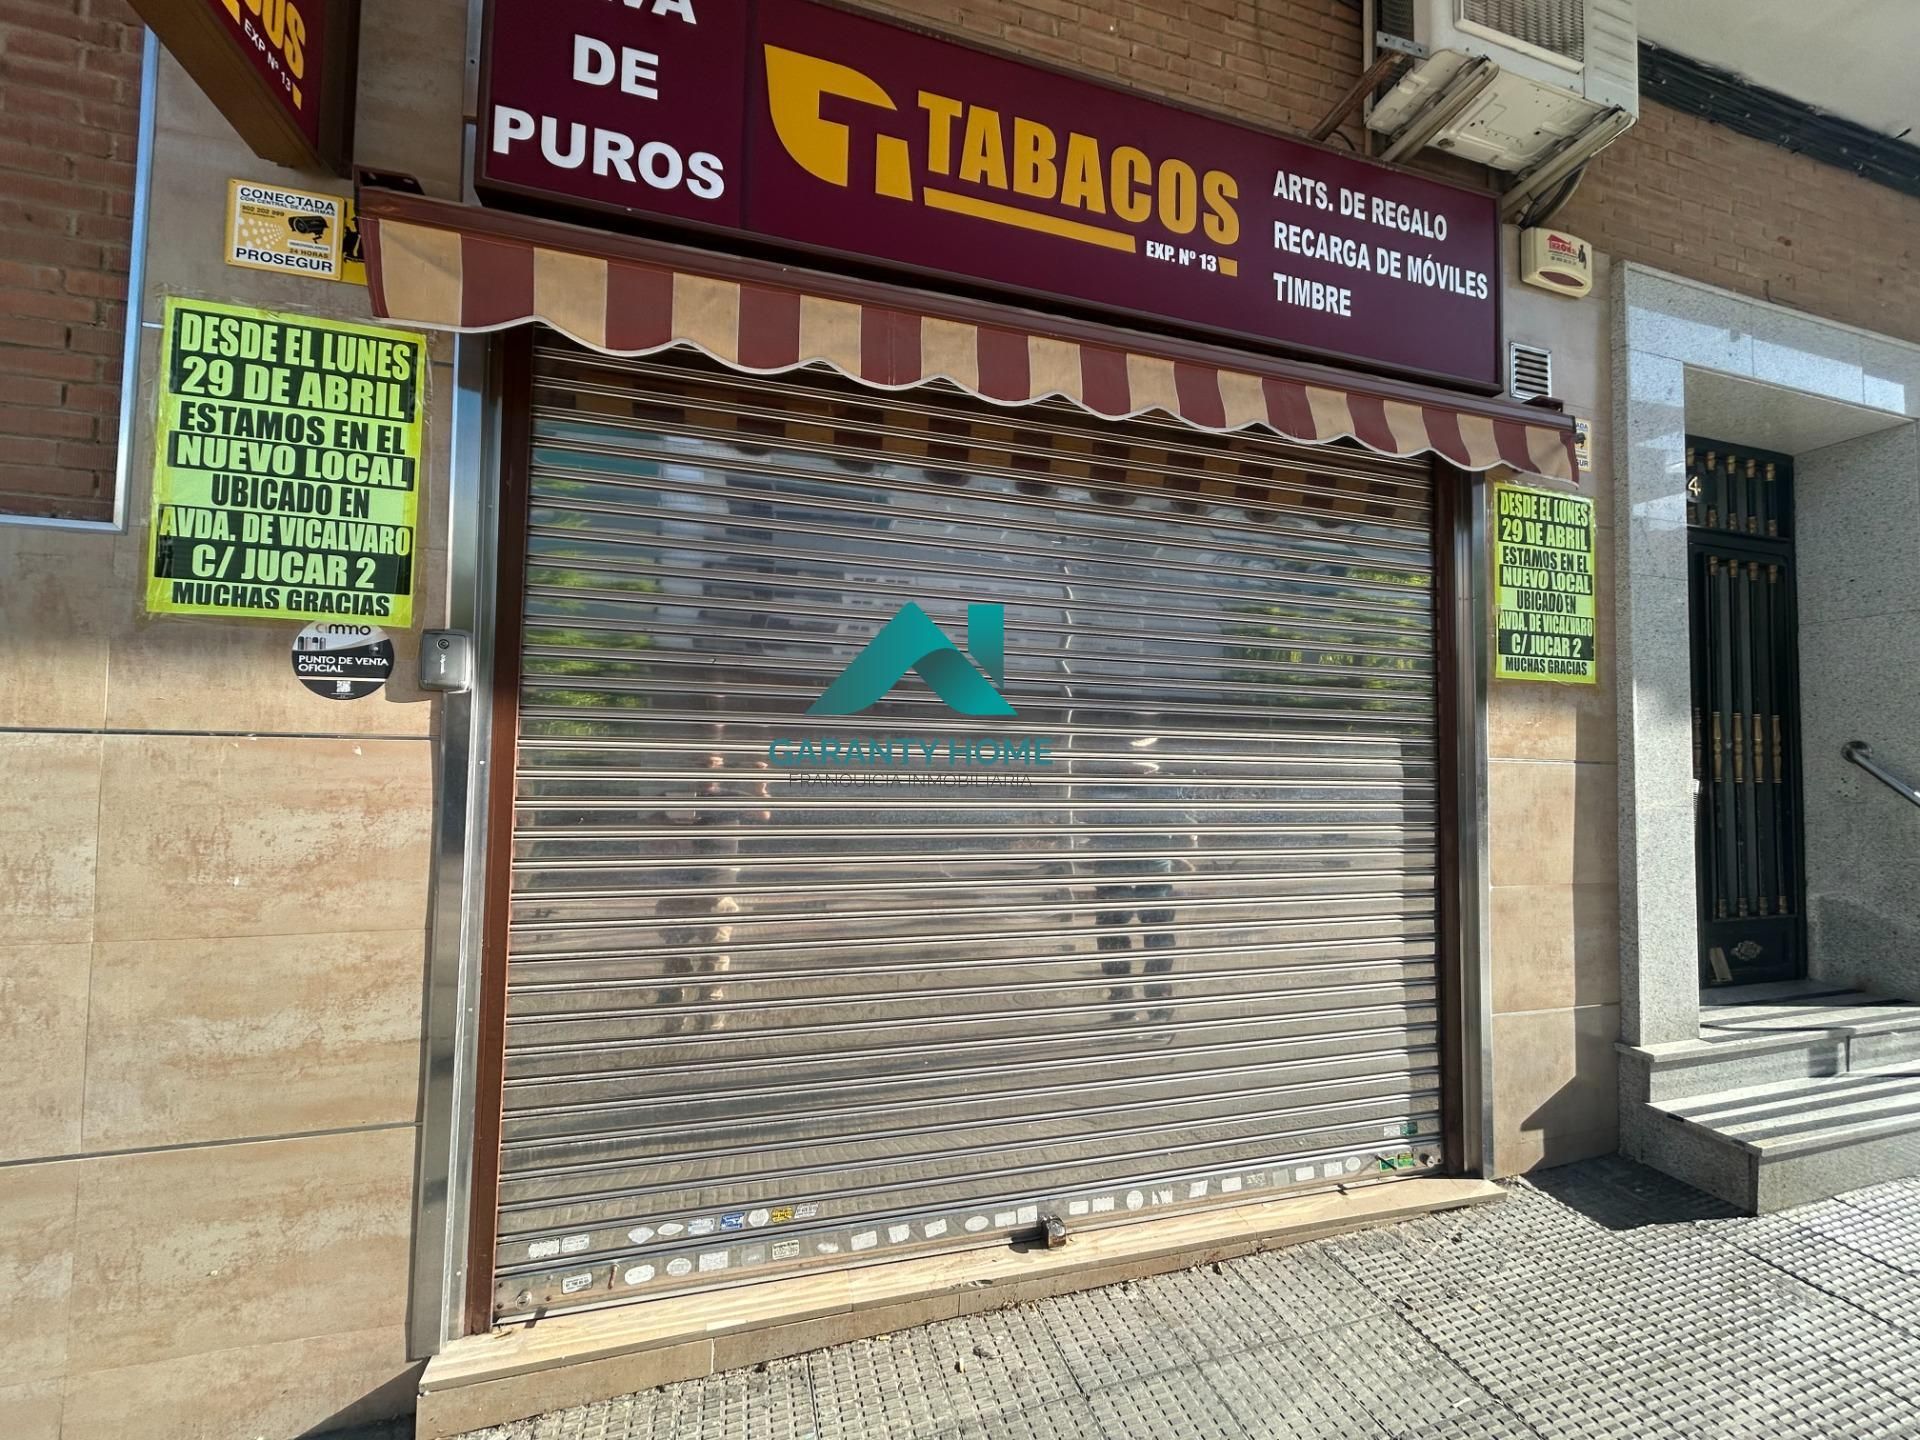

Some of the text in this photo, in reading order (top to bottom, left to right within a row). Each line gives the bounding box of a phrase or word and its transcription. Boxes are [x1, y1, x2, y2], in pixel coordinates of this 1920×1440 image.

[244, 18, 266, 52] EXP
[281, 71, 291, 92] 13
[572, 34, 659, 100] DE
[492, 104, 726, 199] PUROS
[918, 89, 1240, 246] TABACOS
[240, 187, 336, 212] CONECTADA
[240, 195, 256, 204] CON
[257, 198, 289, 209] CENTRAL
[300, 206, 336, 217] ALARMAS
[1273, 170, 1448, 241] ARTS. DE REGALO
[236, 247, 333, 272] PROSEGUR
[300, 250, 329, 259] HORAS
[1146, 240, 1176, 263] EXP.
[1199, 253, 1217, 272] 13
[1274, 220, 1488, 300] RECARGA DE MÓVILES
[1273, 272, 1352, 317] TIMBRE
[180, 312, 410, 380] DESDE EL LUNES
[181, 356, 405, 418] 29 DE ABRIL
[180, 400, 405, 454] ESTAMOS EN EL
[176, 434, 408, 487] NUEVO LOCAL
[211, 473, 370, 518] UBICADO EN
[1688, 476, 1701, 496] 4
[1500, 491, 1588, 527] DESDE EL LUNES
[160, 506, 411, 556] AVDA. DE VICALVARO
[1502, 518, 1587, 551] 29 DE ABRIL
[192, 544, 376, 589] C/ JUCAR 2
[1503, 546, 1588, 573] ESTAMOS EN EL
[1502, 566, 1590, 593] NUEVO LOCAL
[172, 582, 390, 617] MUCHAS GRACIAS
[1517, 590, 1576, 614] UBICADO EN
[1499, 610, 1593, 637] AVDA. DE VICALVARO
[298, 654, 389, 667] PUNTO DE VENTA
[1511, 633, 1582, 658] C/ JUCAR 2
[298, 664, 344, 673] OFICIAL
[1505, 657, 1587, 676] MUCHAS GRACIAS
